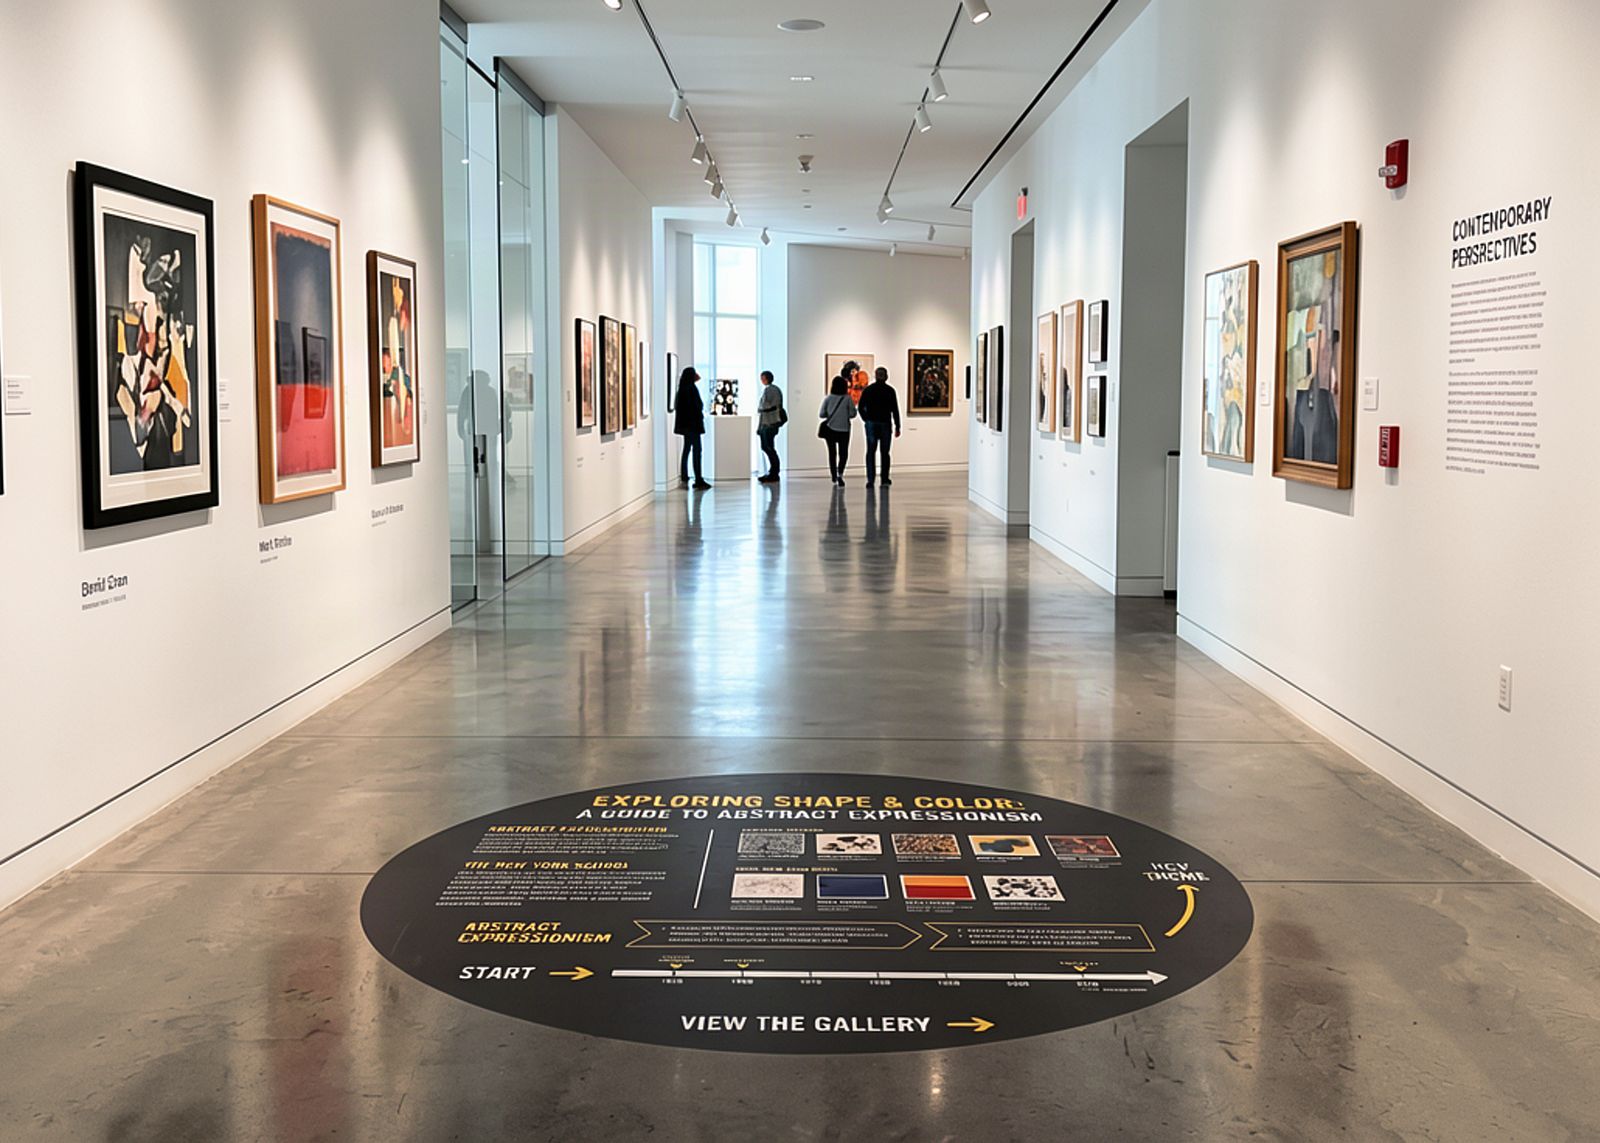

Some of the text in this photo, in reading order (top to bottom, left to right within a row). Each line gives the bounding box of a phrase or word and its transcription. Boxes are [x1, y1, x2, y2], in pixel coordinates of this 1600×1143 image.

[592, 795, 763, 808] EXPLORING
[773, 796, 873, 808] SHAPE
[884, 796, 904, 809] &
[575, 808, 593, 819] A
[682, 809, 709, 820] TO
[717, 809, 840, 820] ABSTRACT
[458, 966, 537, 980] START
[680, 1015, 931, 1033] VIEW THE GALLERY
